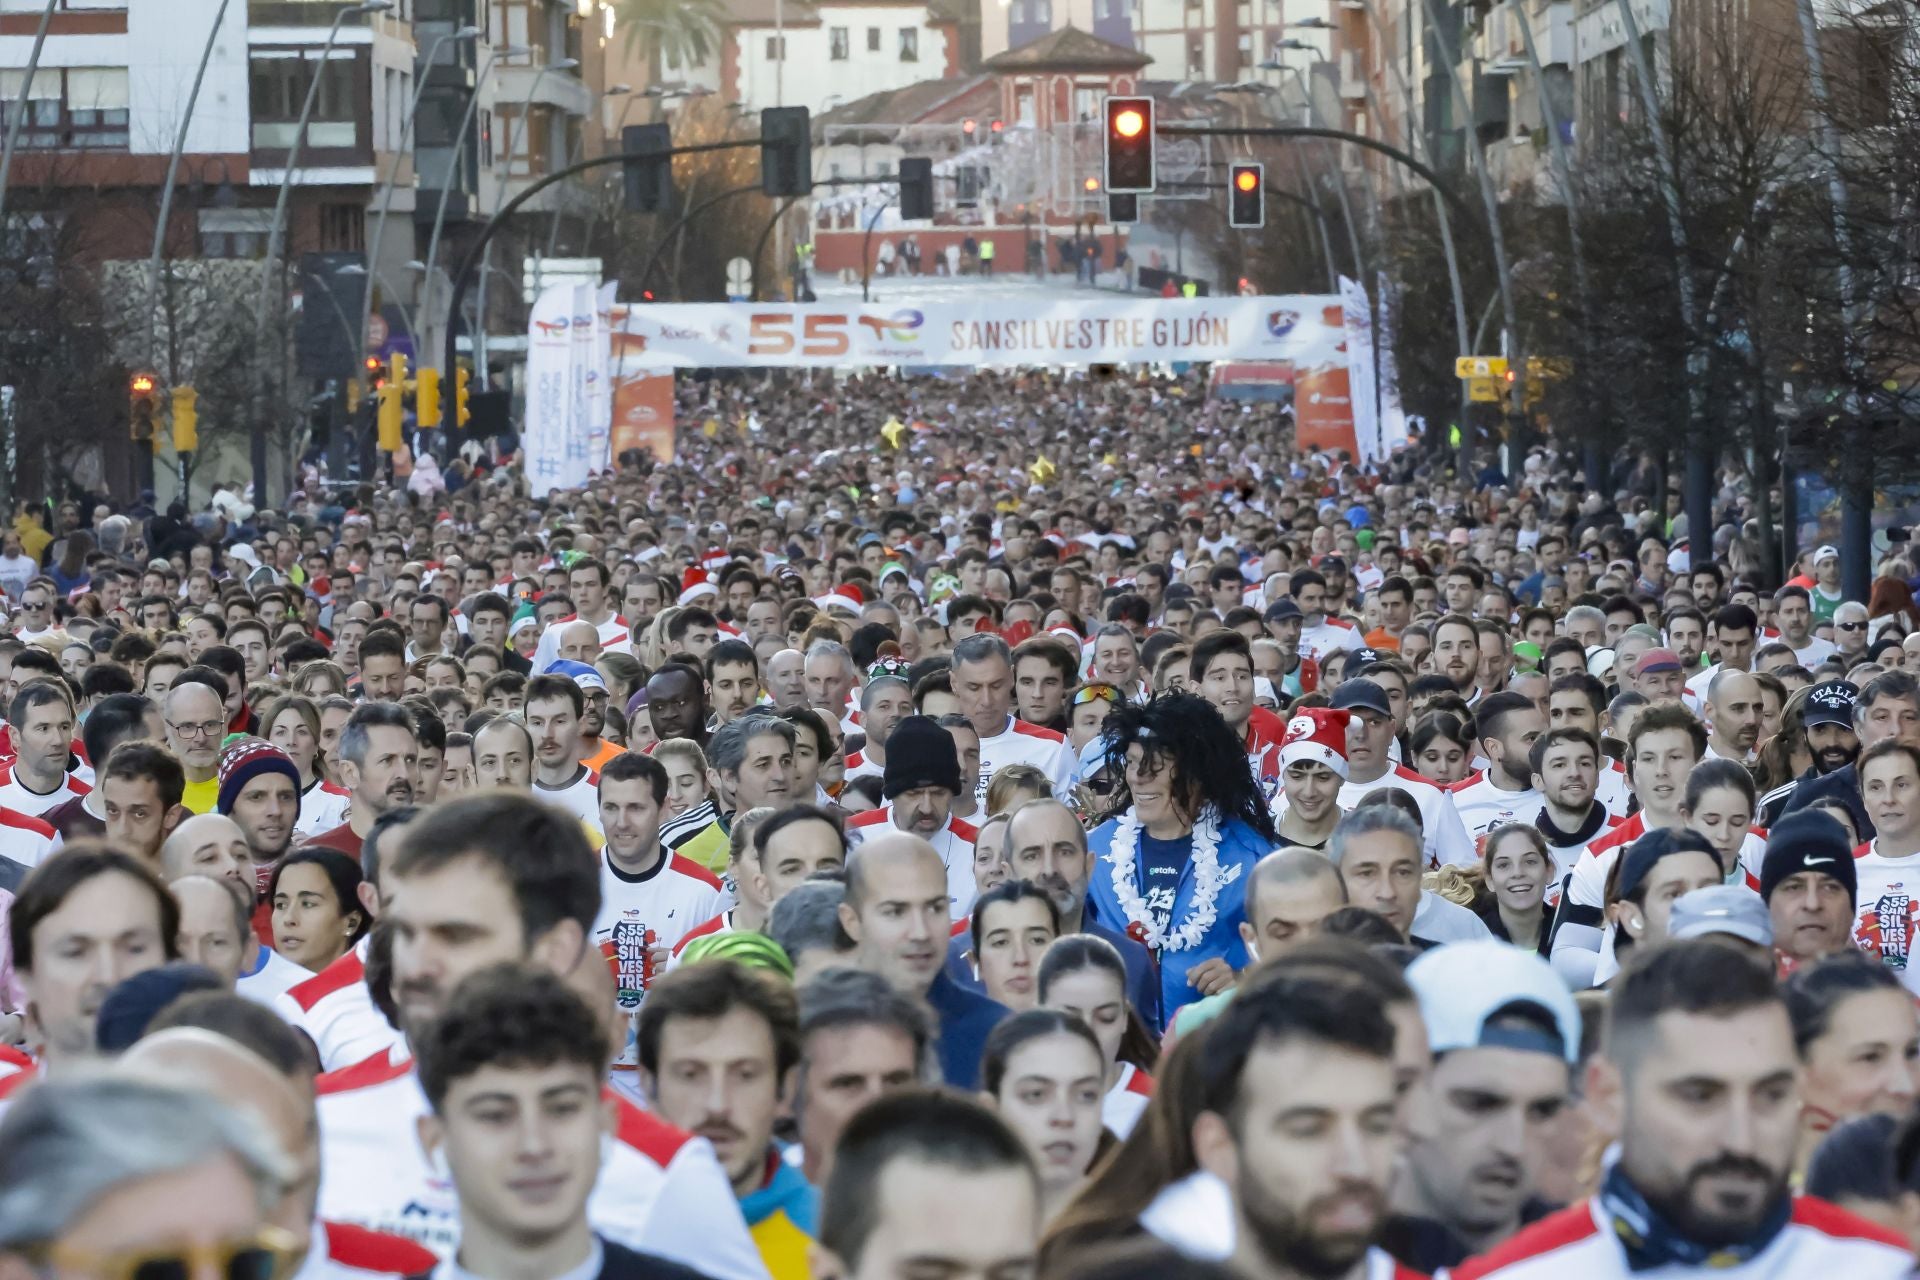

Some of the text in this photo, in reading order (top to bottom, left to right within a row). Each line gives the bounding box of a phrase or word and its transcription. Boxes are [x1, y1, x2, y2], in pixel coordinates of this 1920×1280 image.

[748, 313, 849, 356] 55
[951, 312, 1230, 350] SANSILVESTRE GIJÓN
[1810, 685, 1857, 705] ITALIA
[1890, 896, 1909, 908] 55
[1880, 904, 1907, 916] SAN
[1879, 914, 1905, 929] SIL
[626, 924, 645, 937] 55
[1880, 927, 1907, 942] VES
[618, 931, 644, 947] SAN
[618, 945, 643, 960] SIL
[1878, 942, 1908, 959] TRE
[618, 960, 644, 974] VES
[616, 973, 645, 991] TRE
